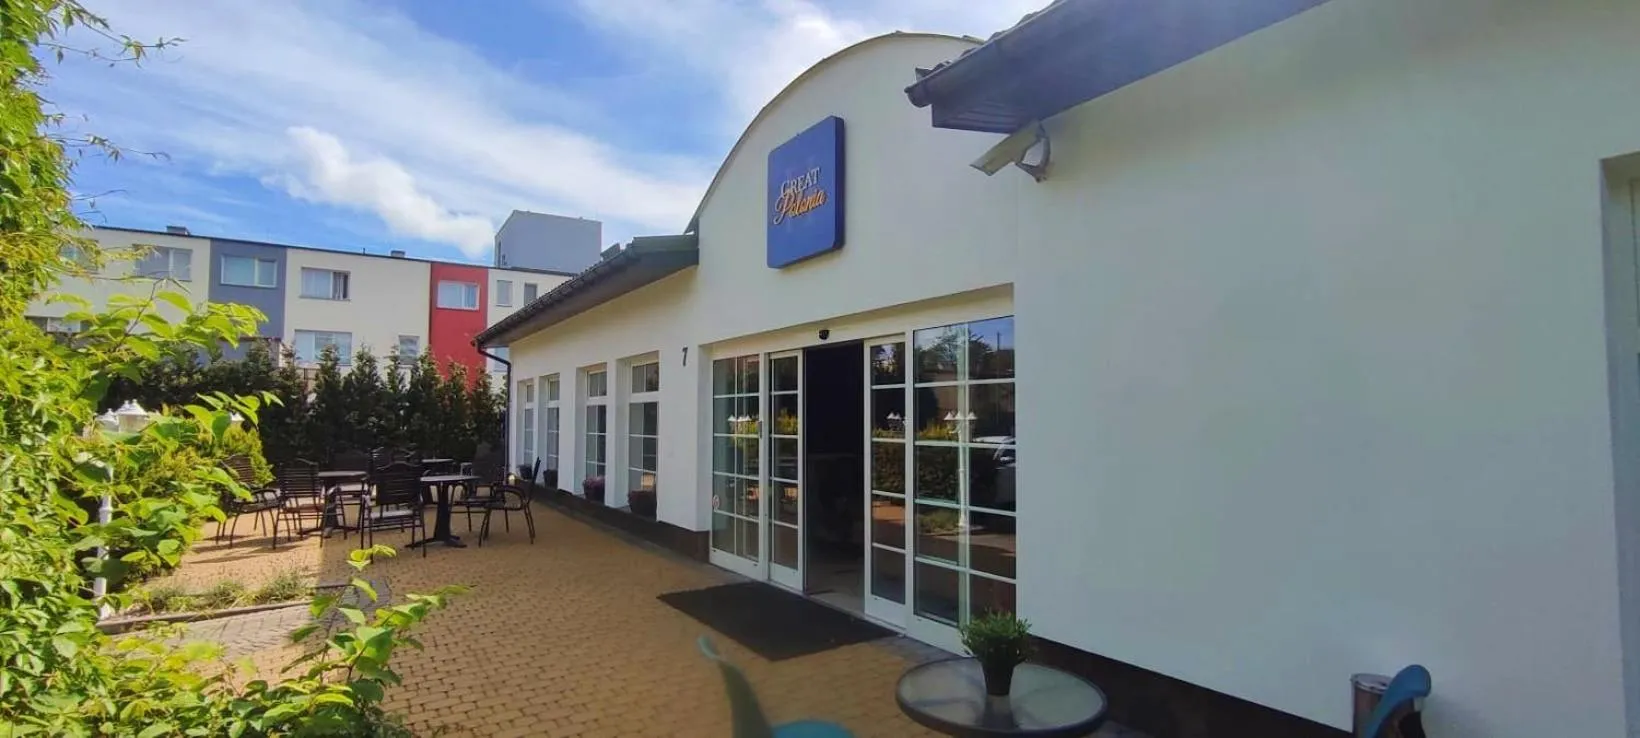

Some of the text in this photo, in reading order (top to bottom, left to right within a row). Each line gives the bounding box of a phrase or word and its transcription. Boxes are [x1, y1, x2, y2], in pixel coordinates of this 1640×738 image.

[781, 166, 820, 197] GREAT
[773, 188, 827, 225] Polonia
[682, 346, 689, 367] 7
